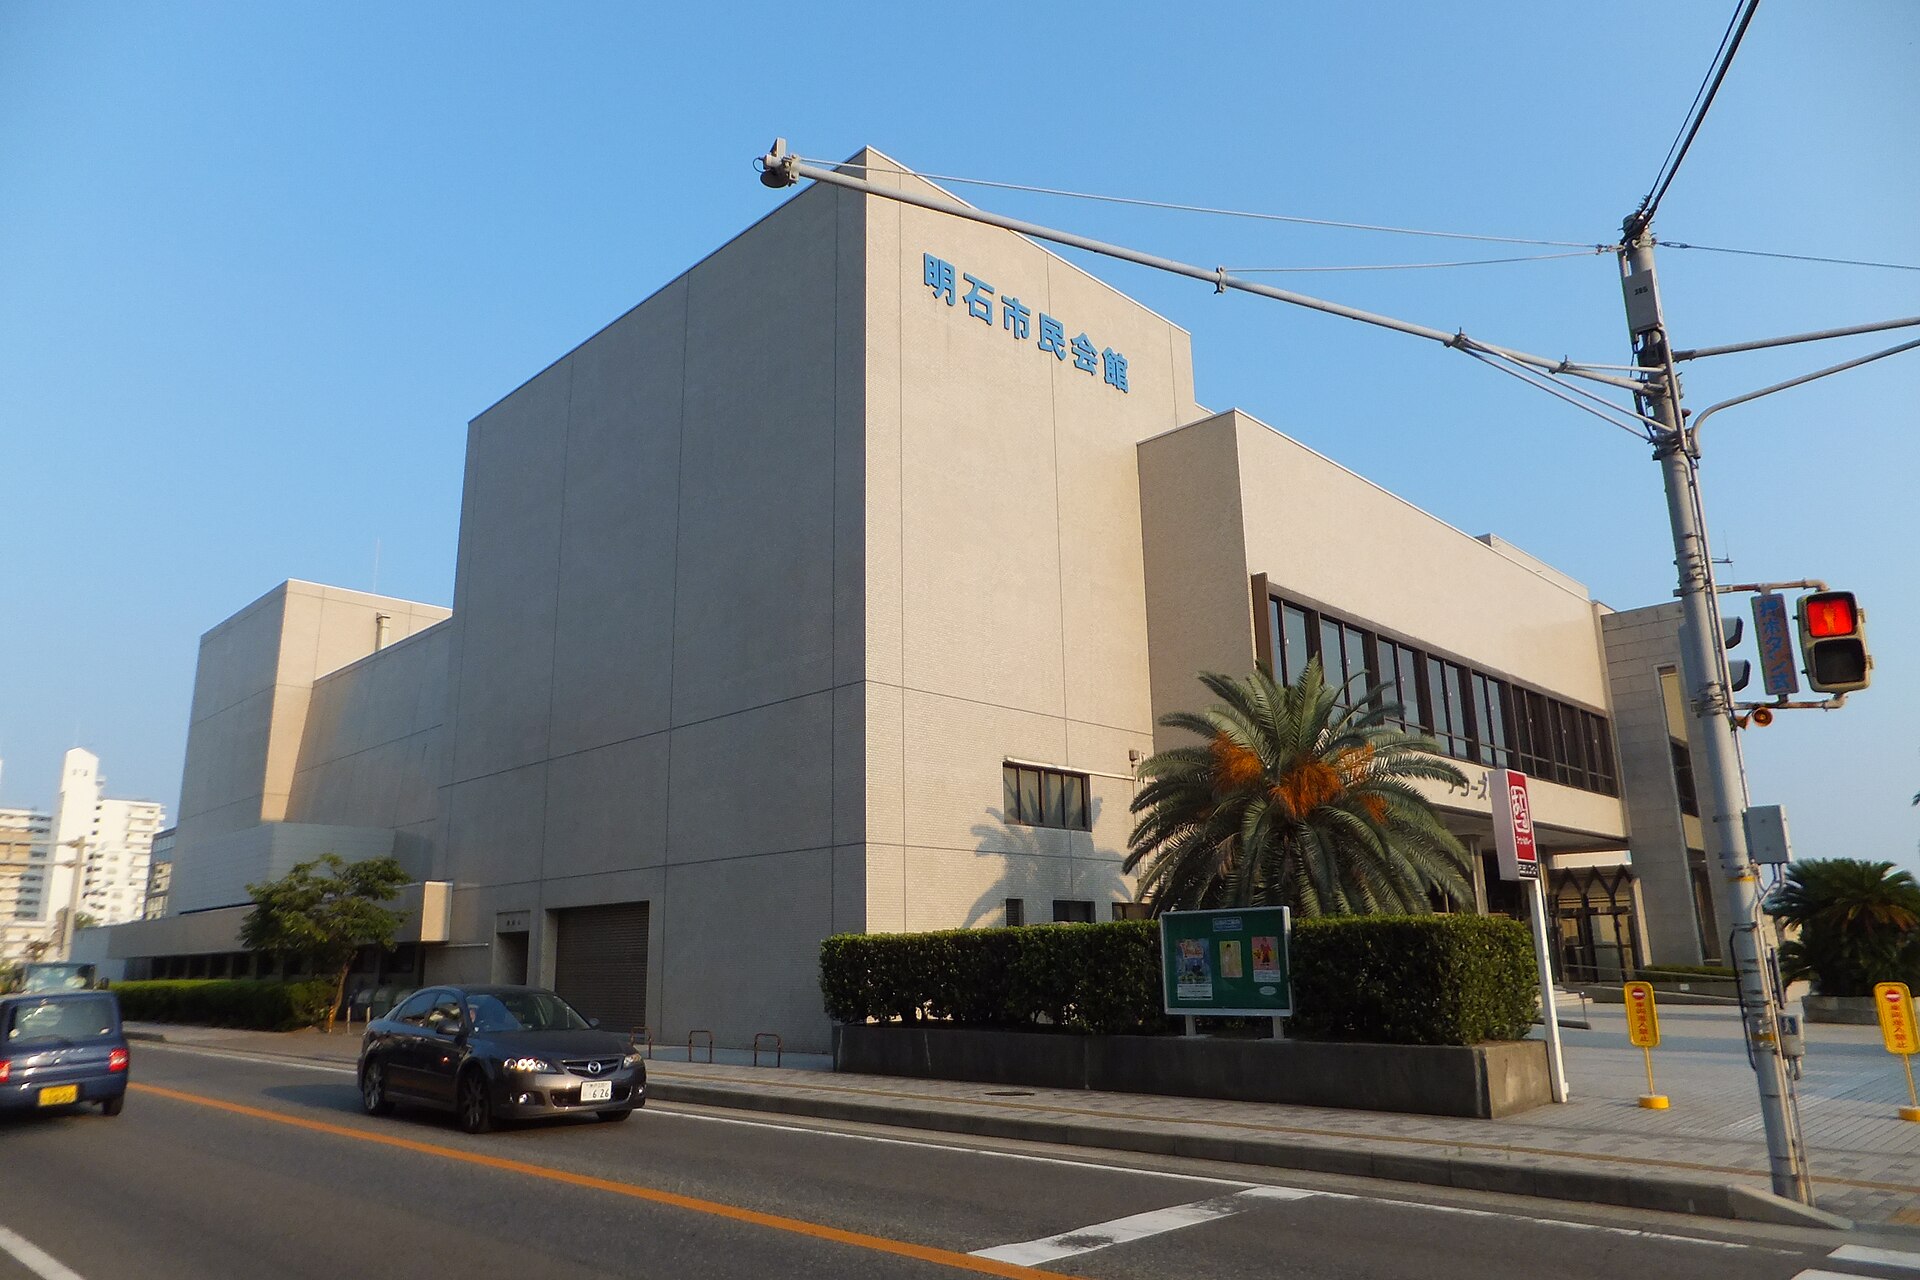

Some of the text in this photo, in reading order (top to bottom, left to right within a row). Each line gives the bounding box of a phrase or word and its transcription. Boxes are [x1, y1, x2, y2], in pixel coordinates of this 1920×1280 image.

[923, 252, 1129, 393] 明石市民会館
